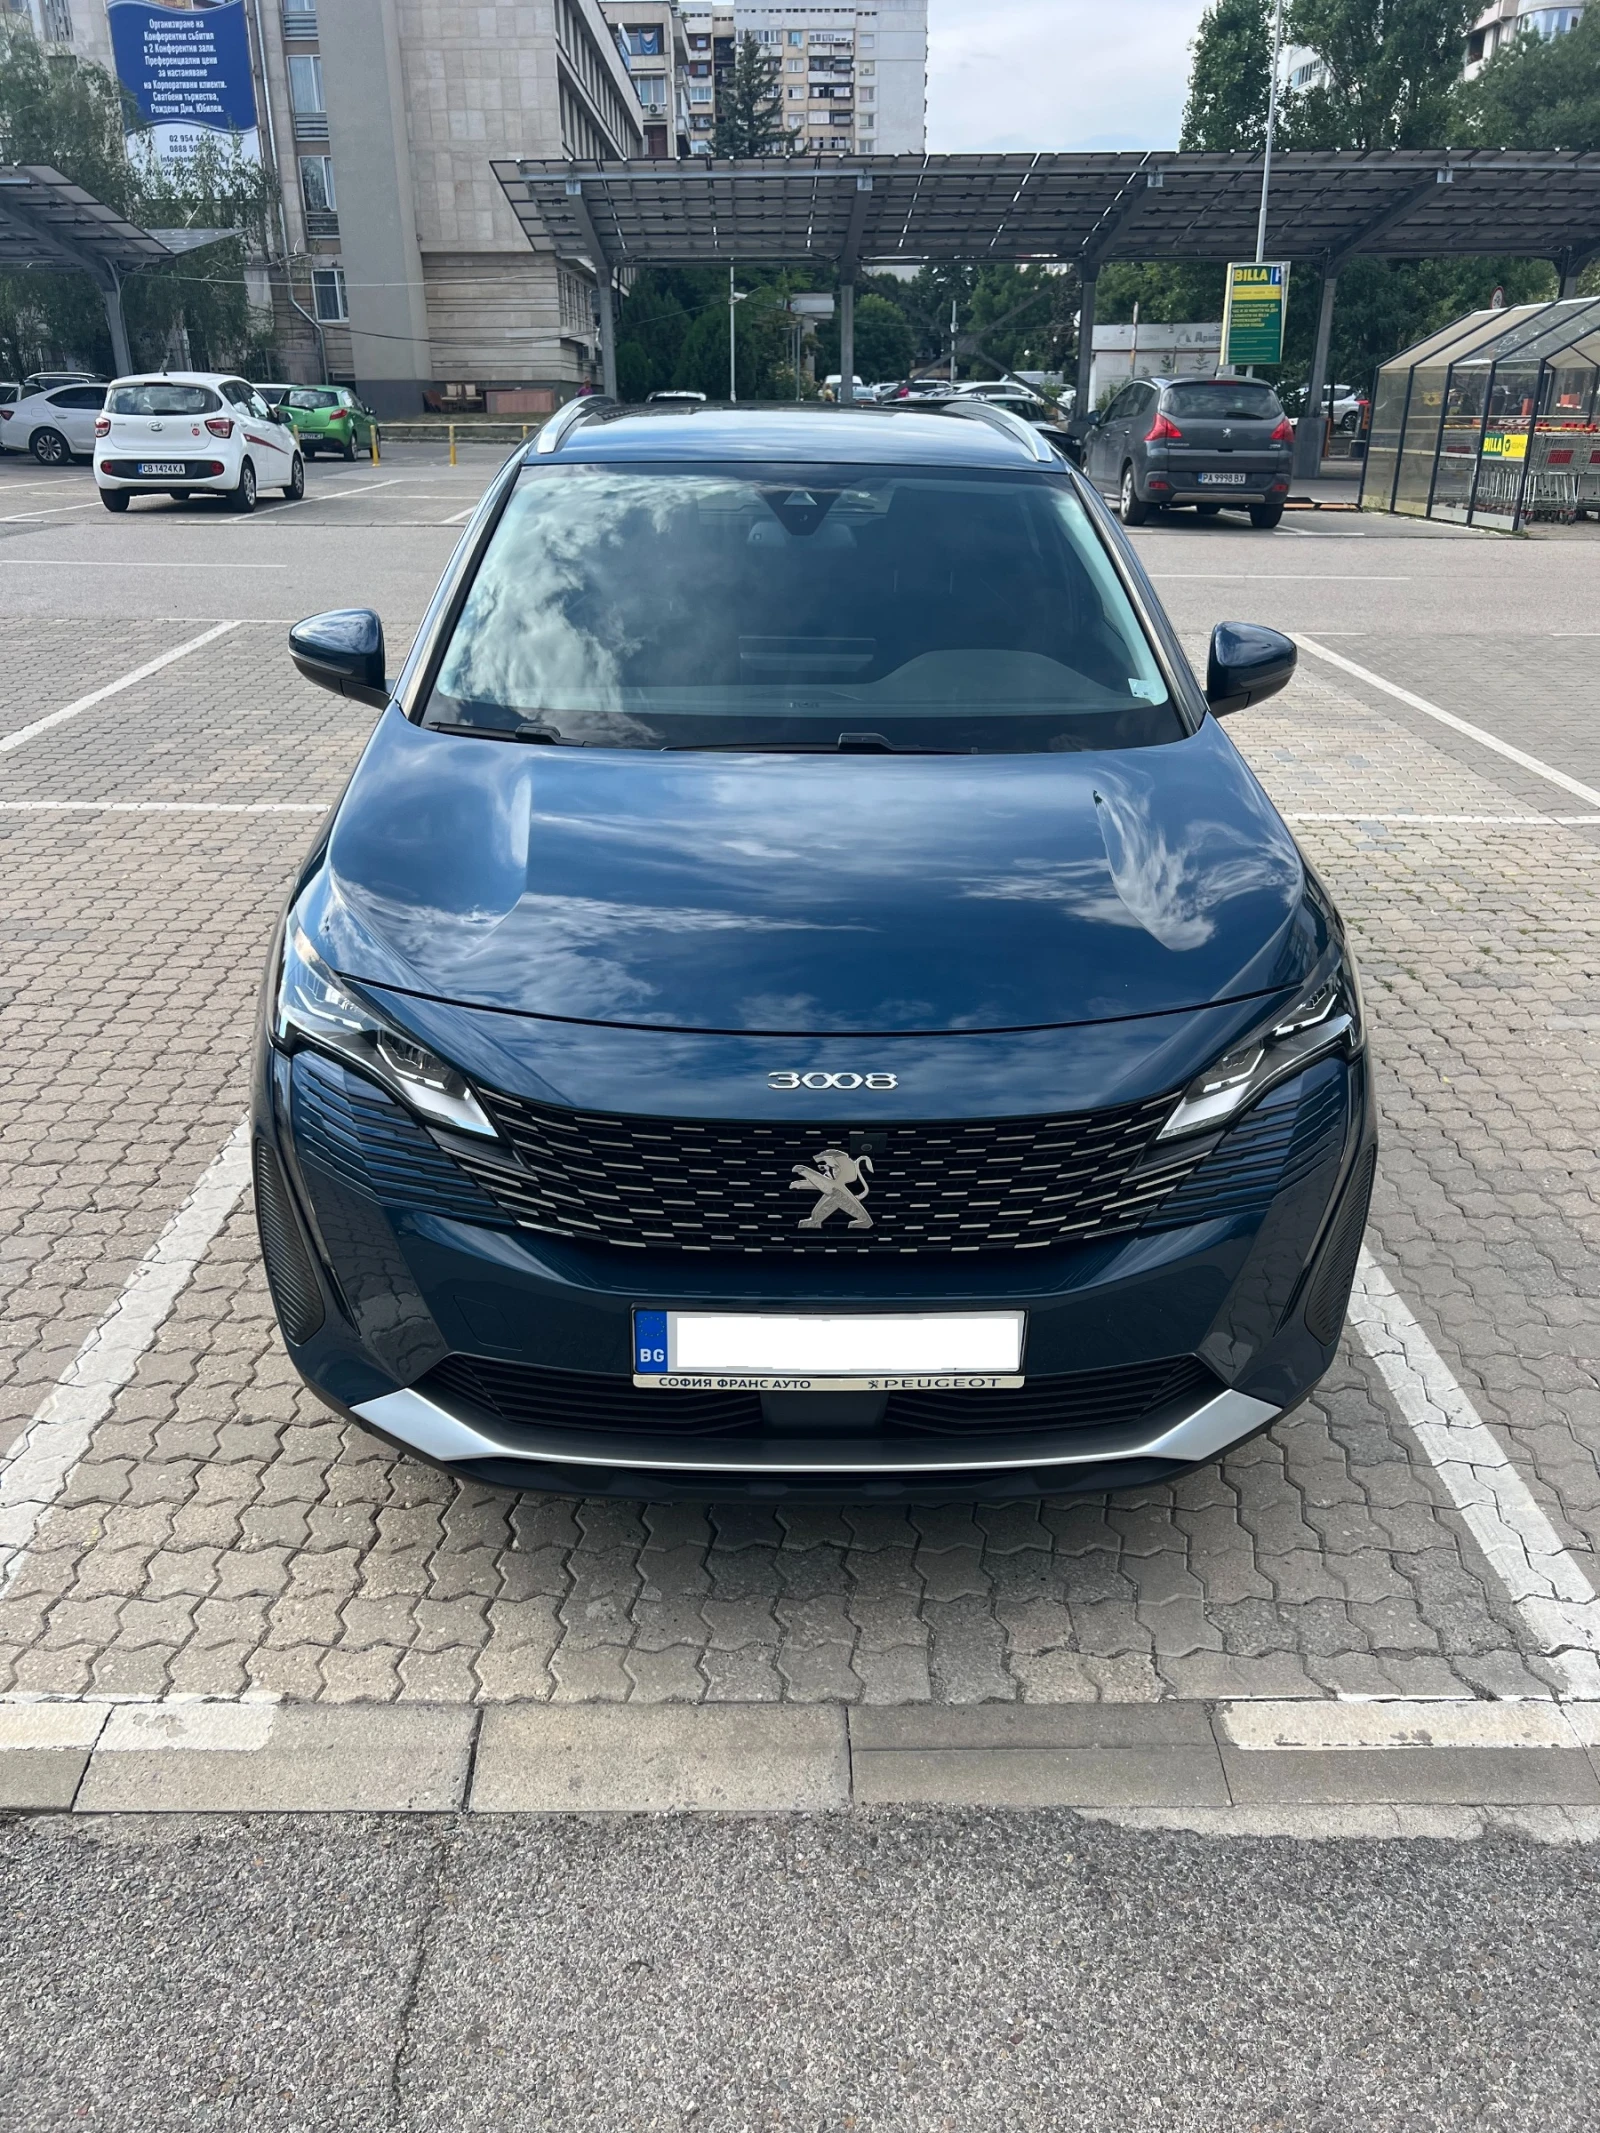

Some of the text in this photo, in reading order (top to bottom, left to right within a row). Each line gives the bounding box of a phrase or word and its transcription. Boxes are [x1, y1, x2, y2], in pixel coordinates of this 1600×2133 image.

[149, 18, 204, 31] Организиране на
[144, 30, 215, 43] Конферентни събития
[143, 43, 216, 55] в 2 Конферентни зали.
[144, 55, 218, 67] Преференциални цени
[158, 69, 208, 77] за настаняване
[143, 80, 227, 91] на Корпоративни клиенти.
[152, 91, 219, 103] Сватбени тържества,
[150, 103, 179, 113] Рождени
[169, 134, 178, 142] 02
[180, 134, 194, 142] 954
[169, 145, 187, 153] 0888
[1234, 268, 1268, 281] BILLA
[1483, 437, 1502, 452] BILLA
[143, 464, 184, 473] CB 1424 KA
[1203, 473, 1245, 483] PA 9998 BX
[767, 1072, 899, 1090] 3008
[639, 1348, 665, 1363] BG
[658, 1377, 811, 1389] СОФИЯ ФРАНС АУТО
[884, 1378, 1001, 1389] PEUGEOT
